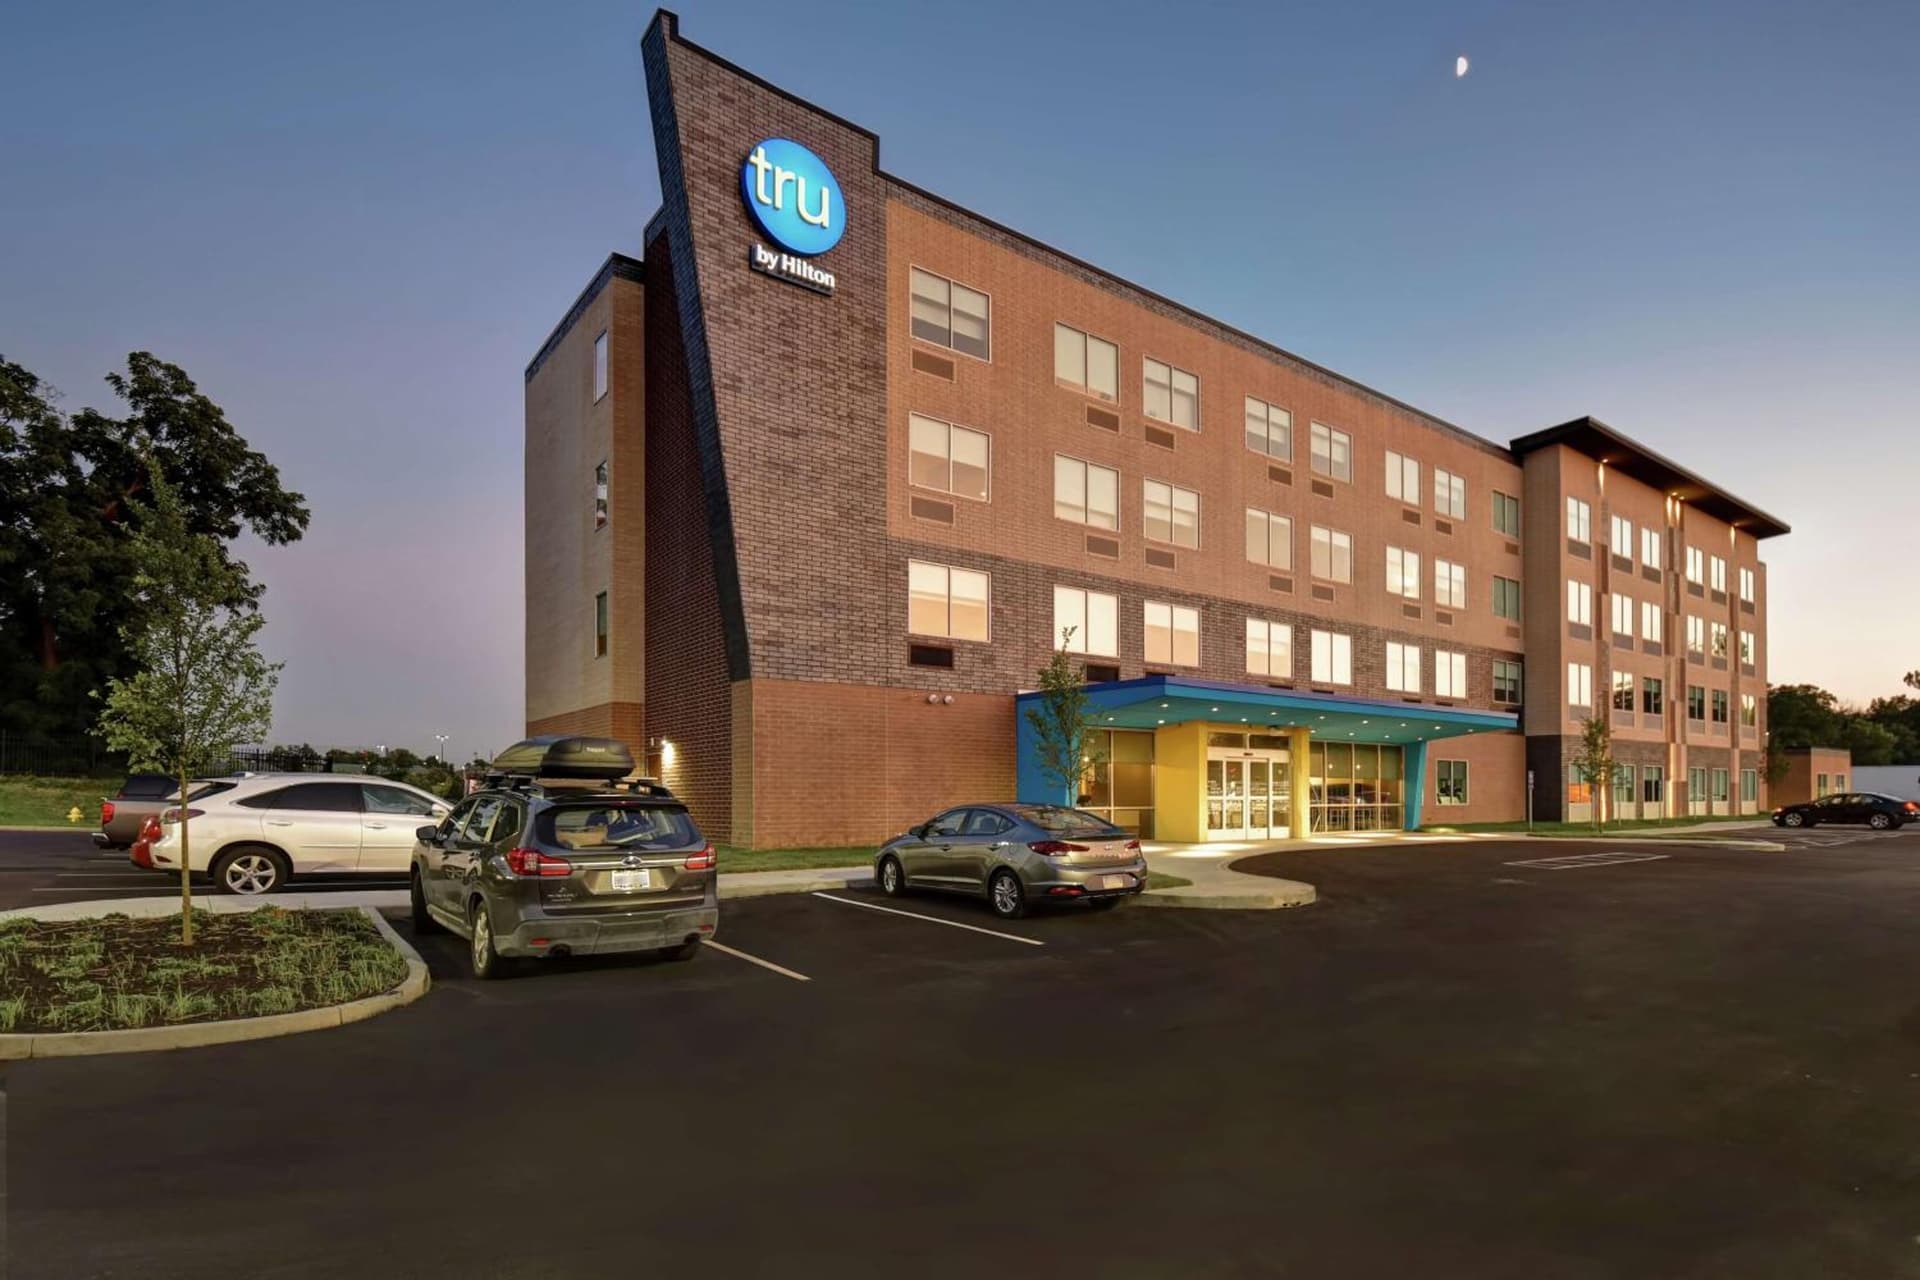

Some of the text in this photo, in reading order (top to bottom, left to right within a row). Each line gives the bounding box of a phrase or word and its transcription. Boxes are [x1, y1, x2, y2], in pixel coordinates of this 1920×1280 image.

[750, 146, 829, 228] tru
[757, 244, 835, 288] by Hilton
